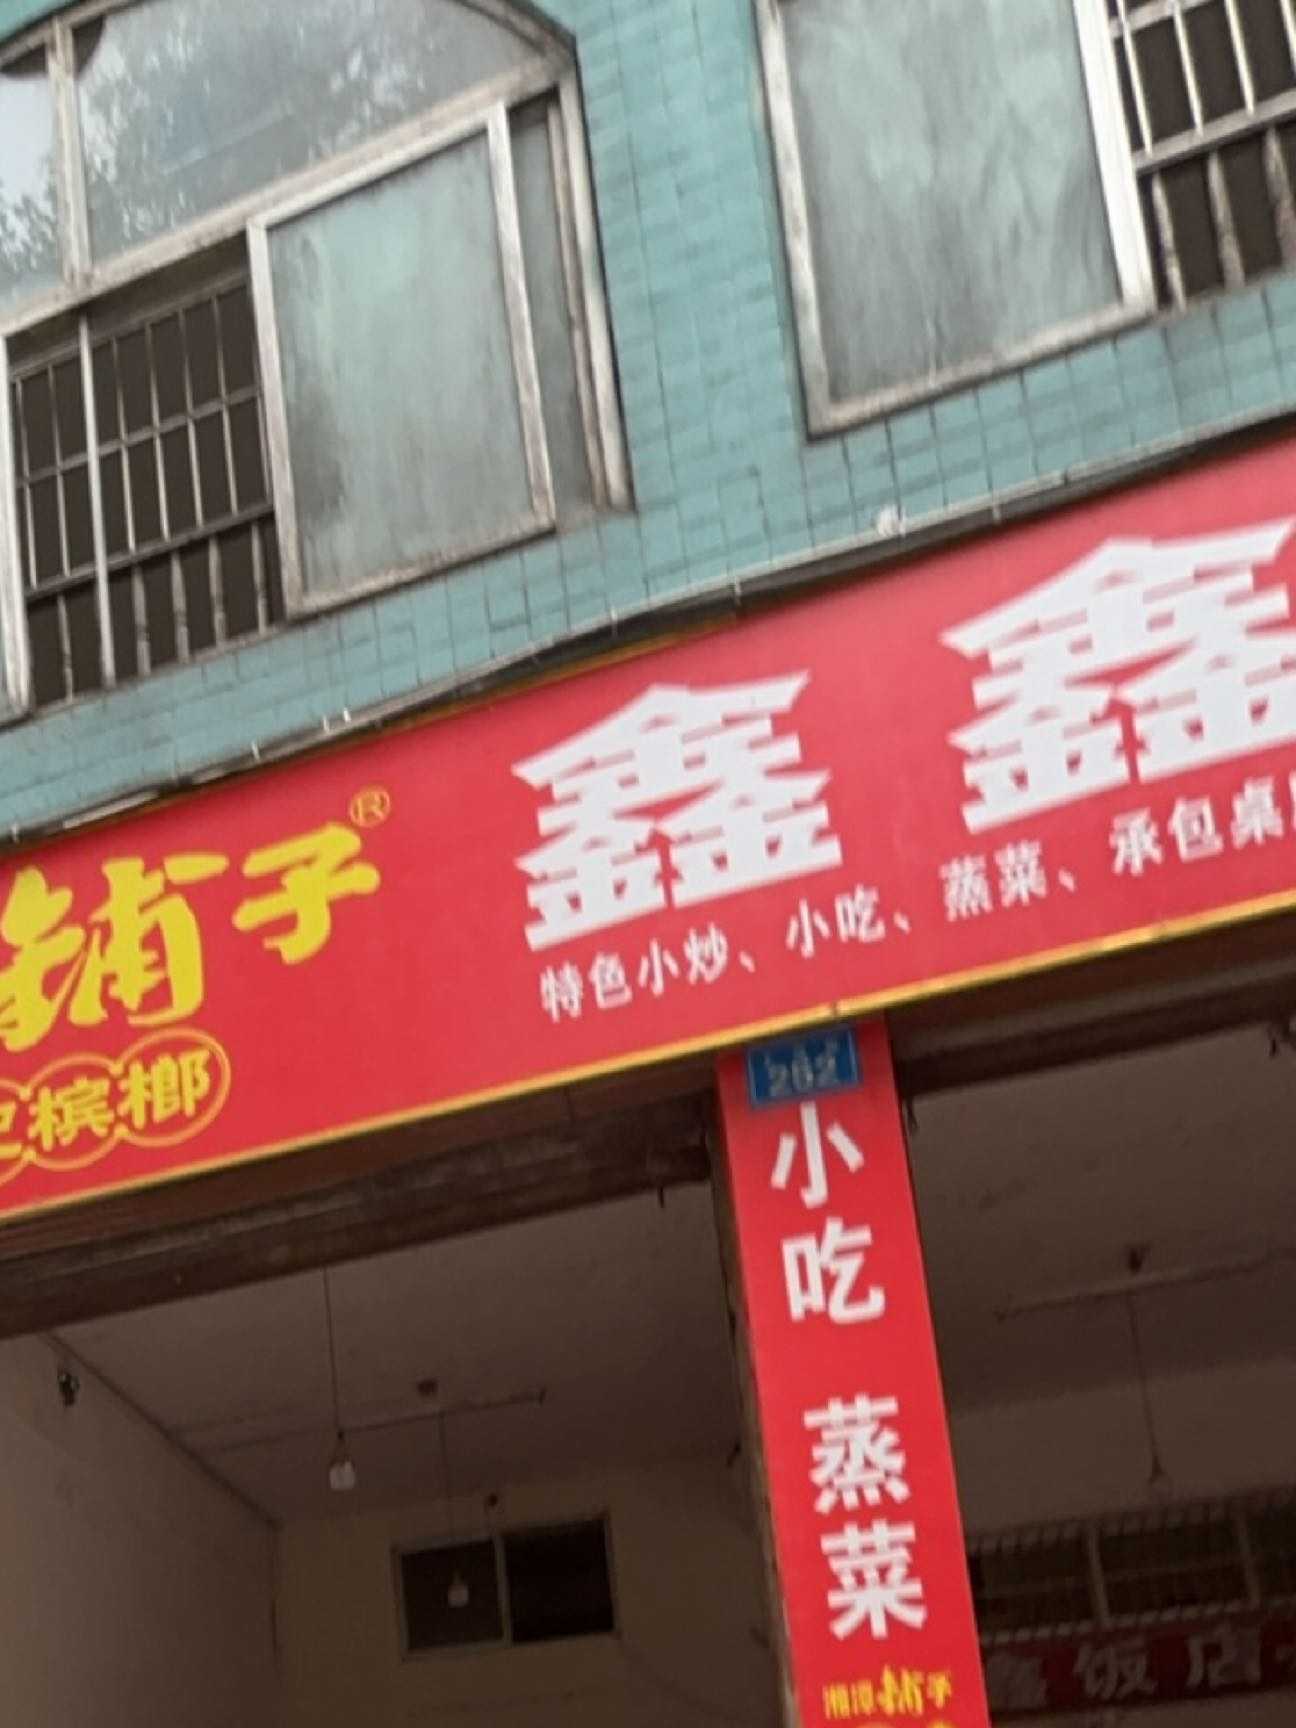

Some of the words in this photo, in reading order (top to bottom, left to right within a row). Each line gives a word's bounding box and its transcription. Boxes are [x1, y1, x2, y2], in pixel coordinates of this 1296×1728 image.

[539, 778, 1296, 1022] 特色小炒、小吃、蒸菜、承包桌
[770, 1102, 887, 1325] 小吃
[803, 1393, 928, 1640] 蒸菜
